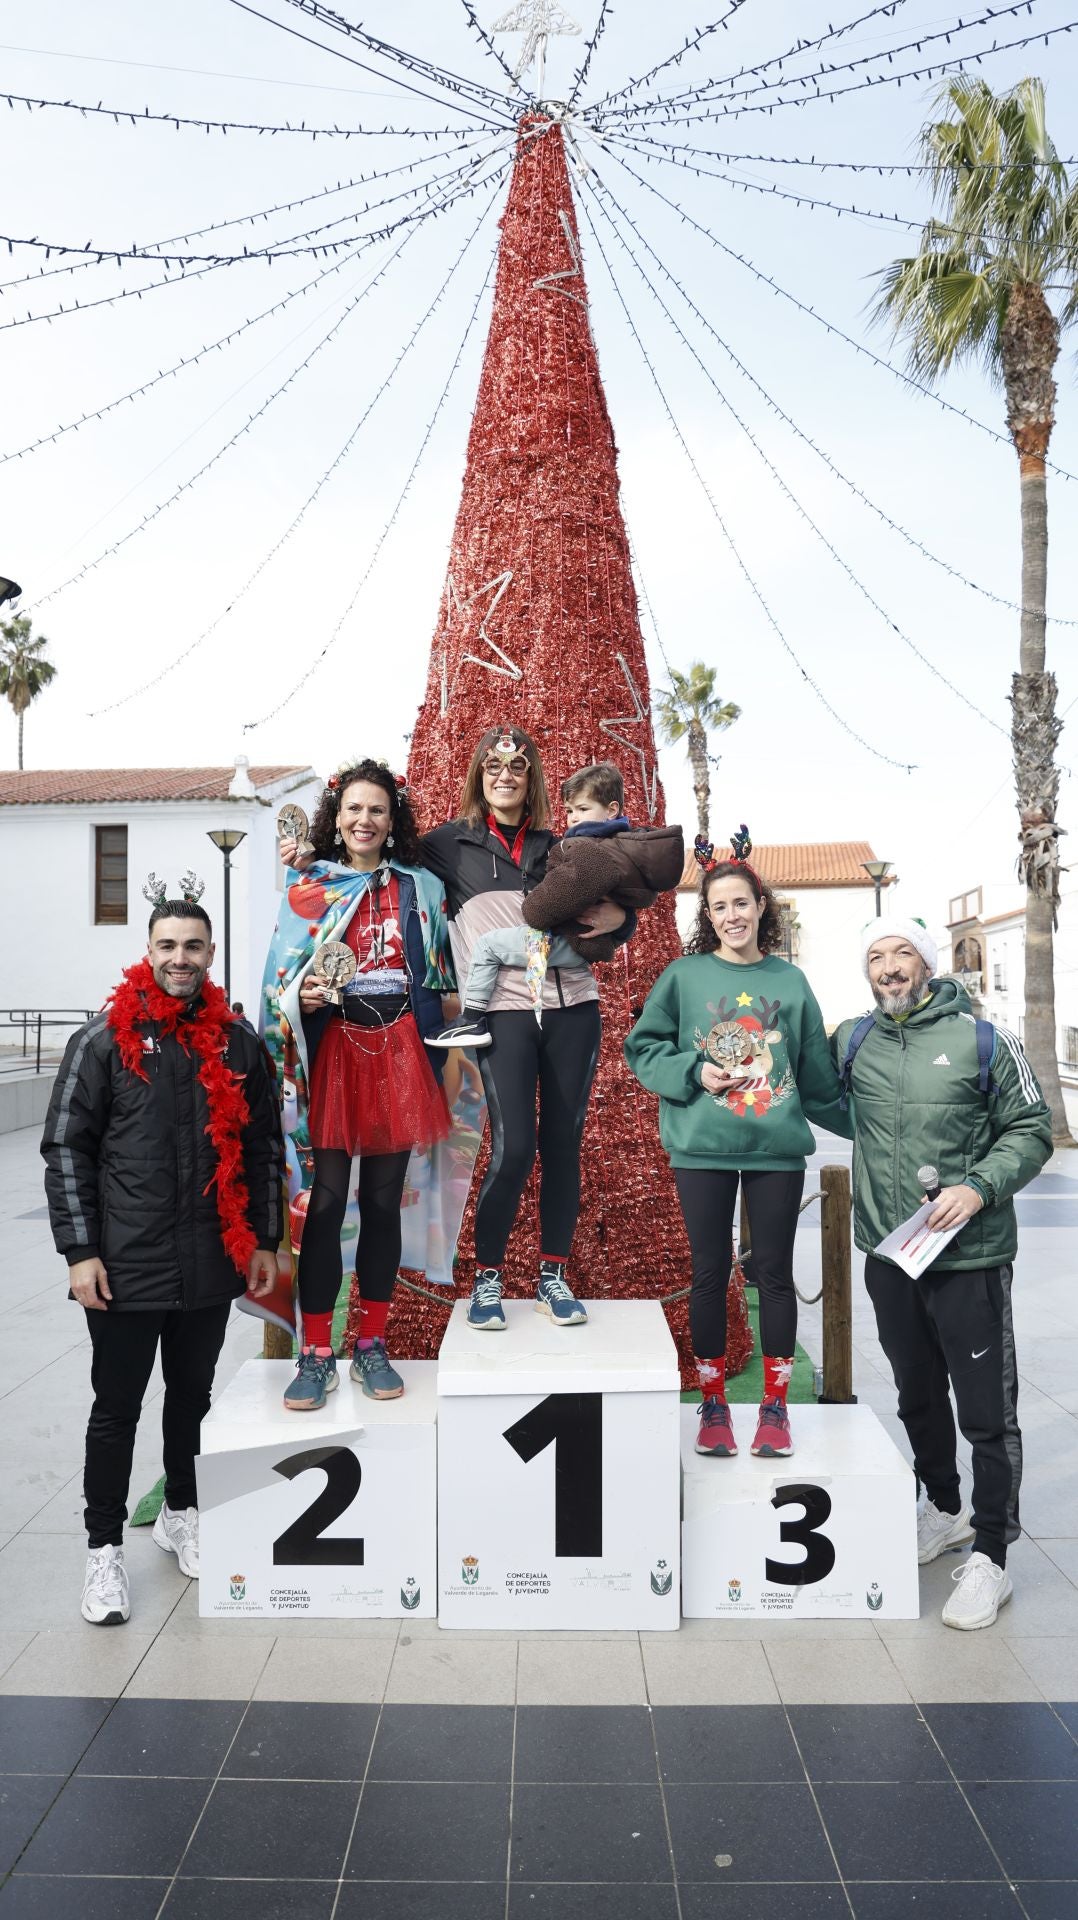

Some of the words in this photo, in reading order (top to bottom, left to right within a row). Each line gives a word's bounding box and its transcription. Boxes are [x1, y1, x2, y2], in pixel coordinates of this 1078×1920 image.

[272, 1446, 365, 1566] 2
[502, 1393, 603, 1558] 1
[506, 1572, 548, 1580] CONCEJALÍA
[765, 1484, 836, 1586] 3
[515, 1588, 549, 1596] JUVENTUD
